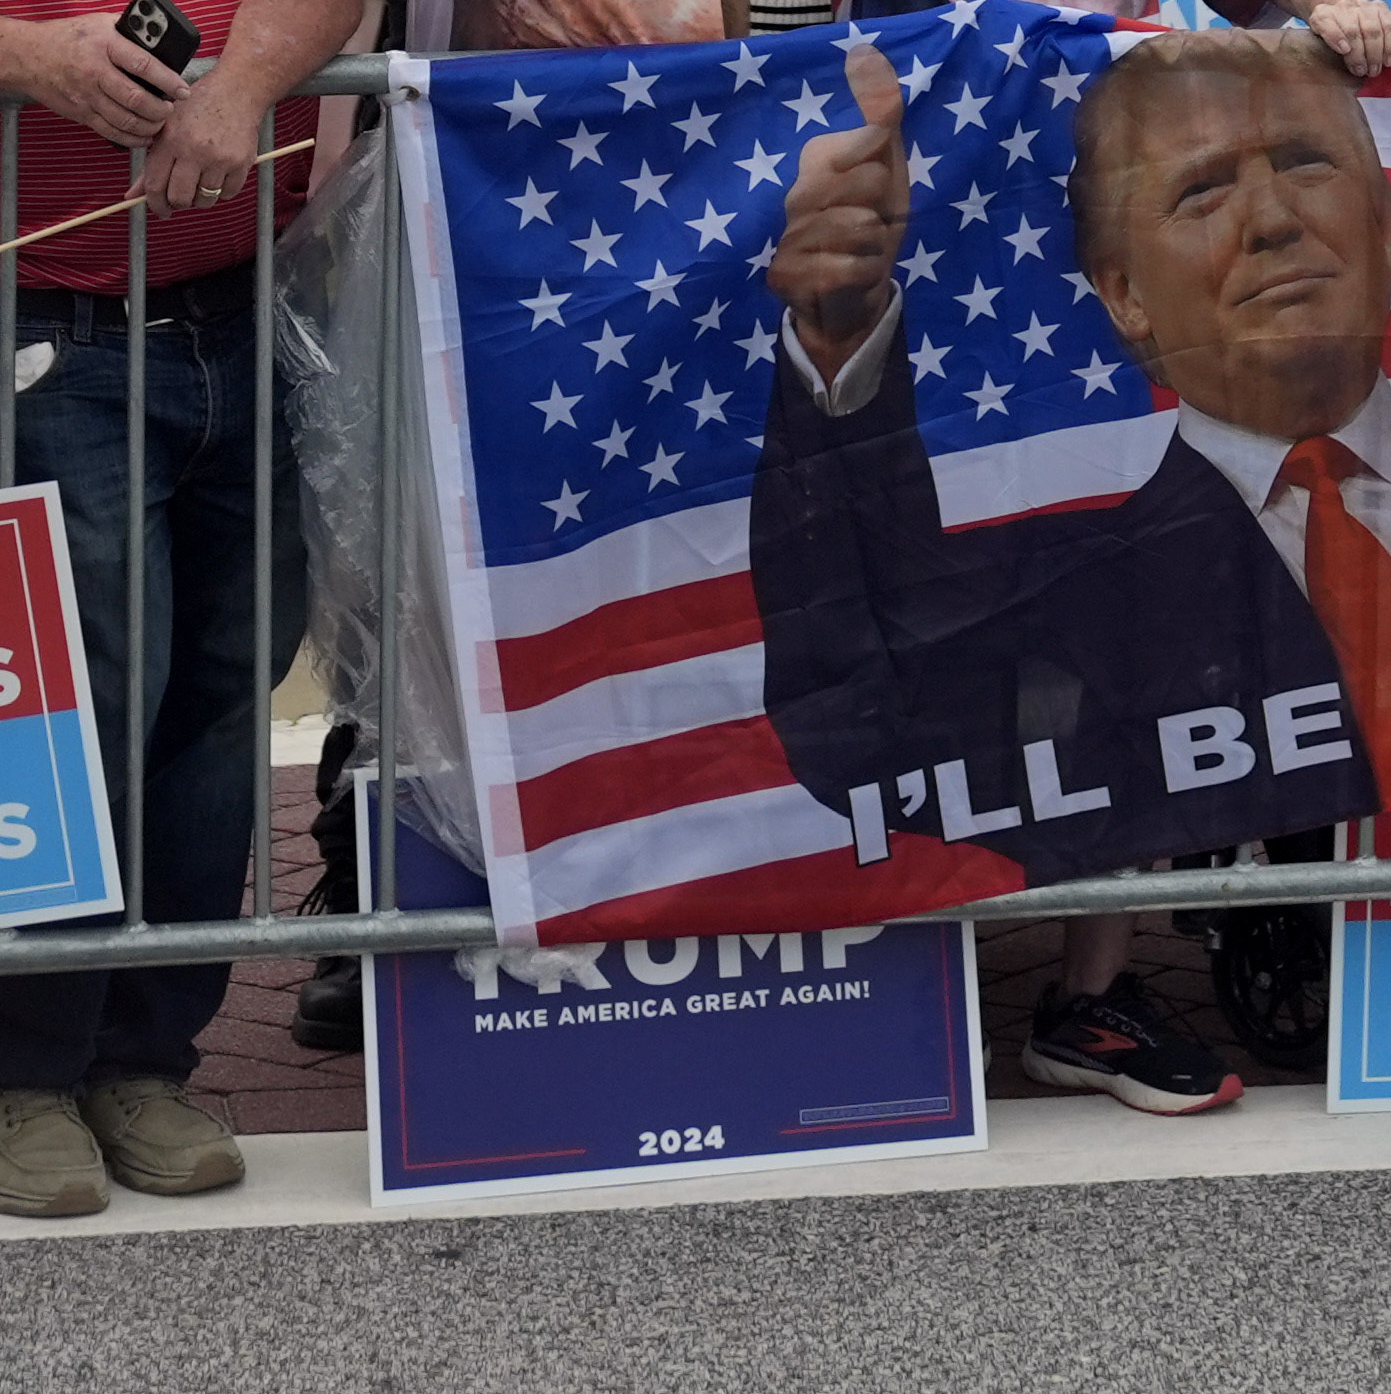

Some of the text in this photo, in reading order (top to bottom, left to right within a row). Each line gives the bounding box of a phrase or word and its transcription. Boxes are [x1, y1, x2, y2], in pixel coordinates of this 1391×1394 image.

[1156, 680, 1354, 794] BE
[475, 980, 871, 1034] MAKE AMERICA GREAT AGAIN!
[637, 1124, 726, 1158] 2024
